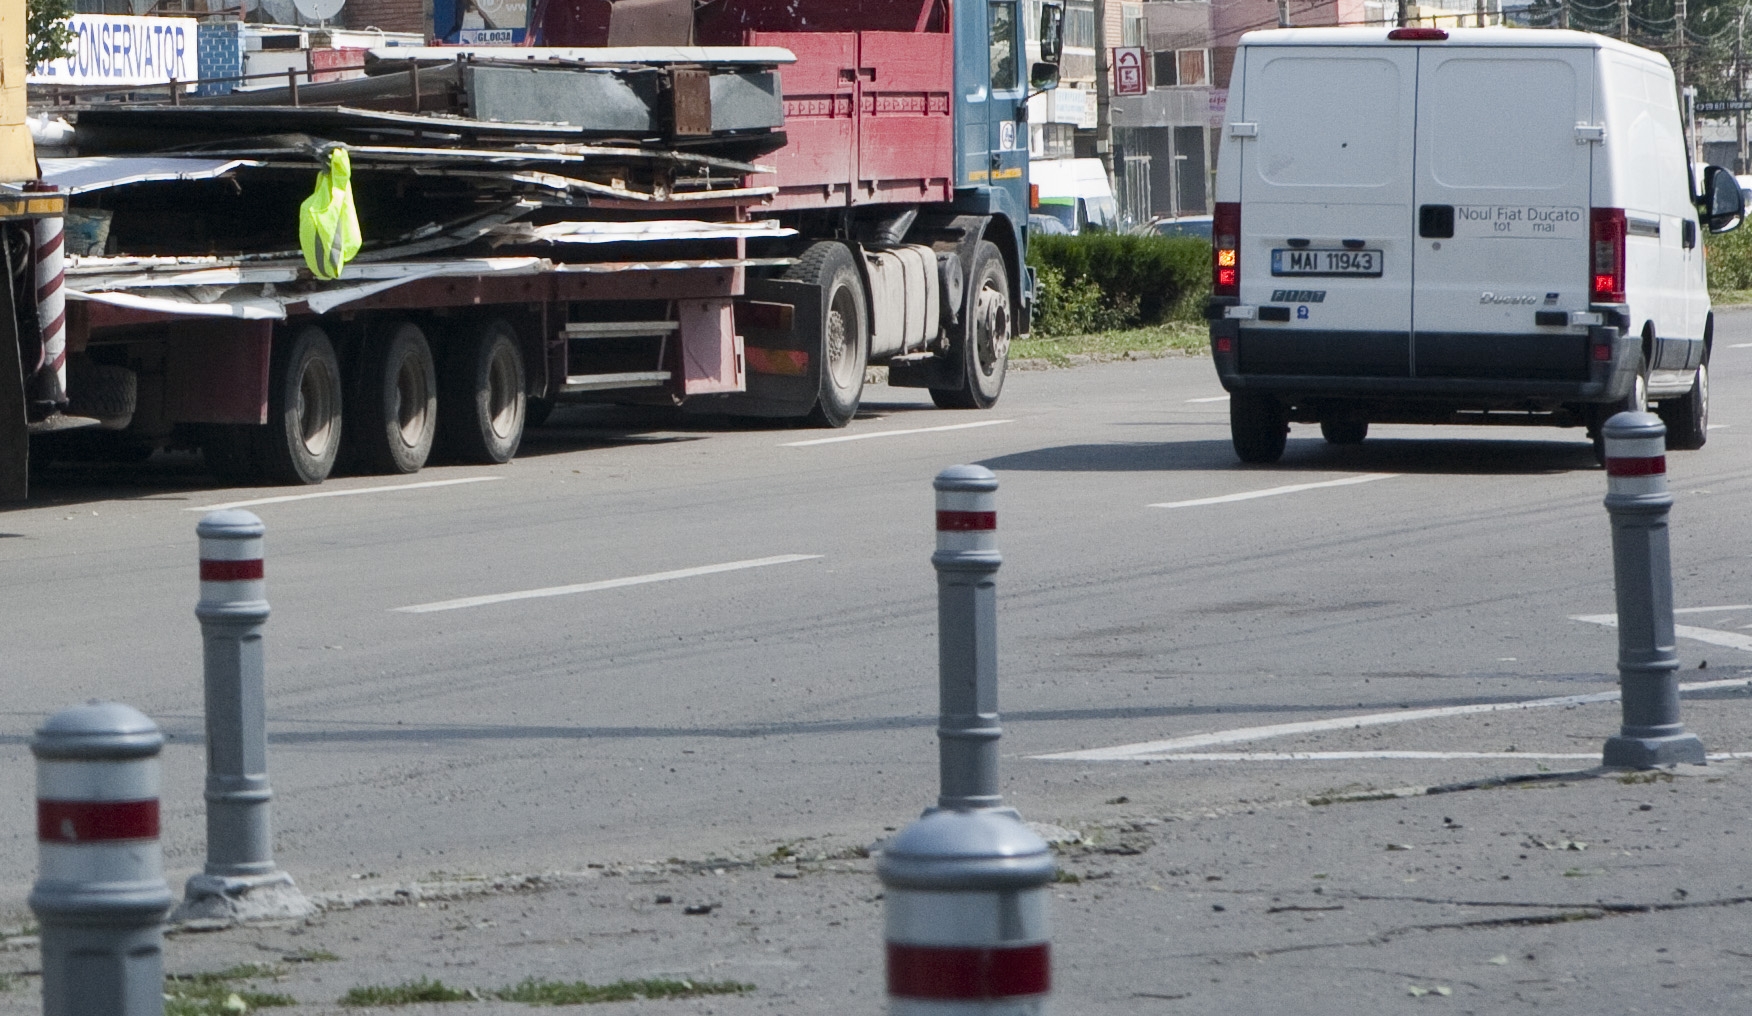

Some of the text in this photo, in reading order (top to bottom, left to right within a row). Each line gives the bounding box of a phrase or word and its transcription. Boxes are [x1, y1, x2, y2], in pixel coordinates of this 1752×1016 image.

[1458, 207, 1580, 222] Noul Fiat Ducato
[1494, 221, 1556, 232] tot mai
[1290, 252, 1373, 271] MAI 11943
[1272, 290, 1325, 302] FIAT
[1479, 291, 1537, 305] Ducato
